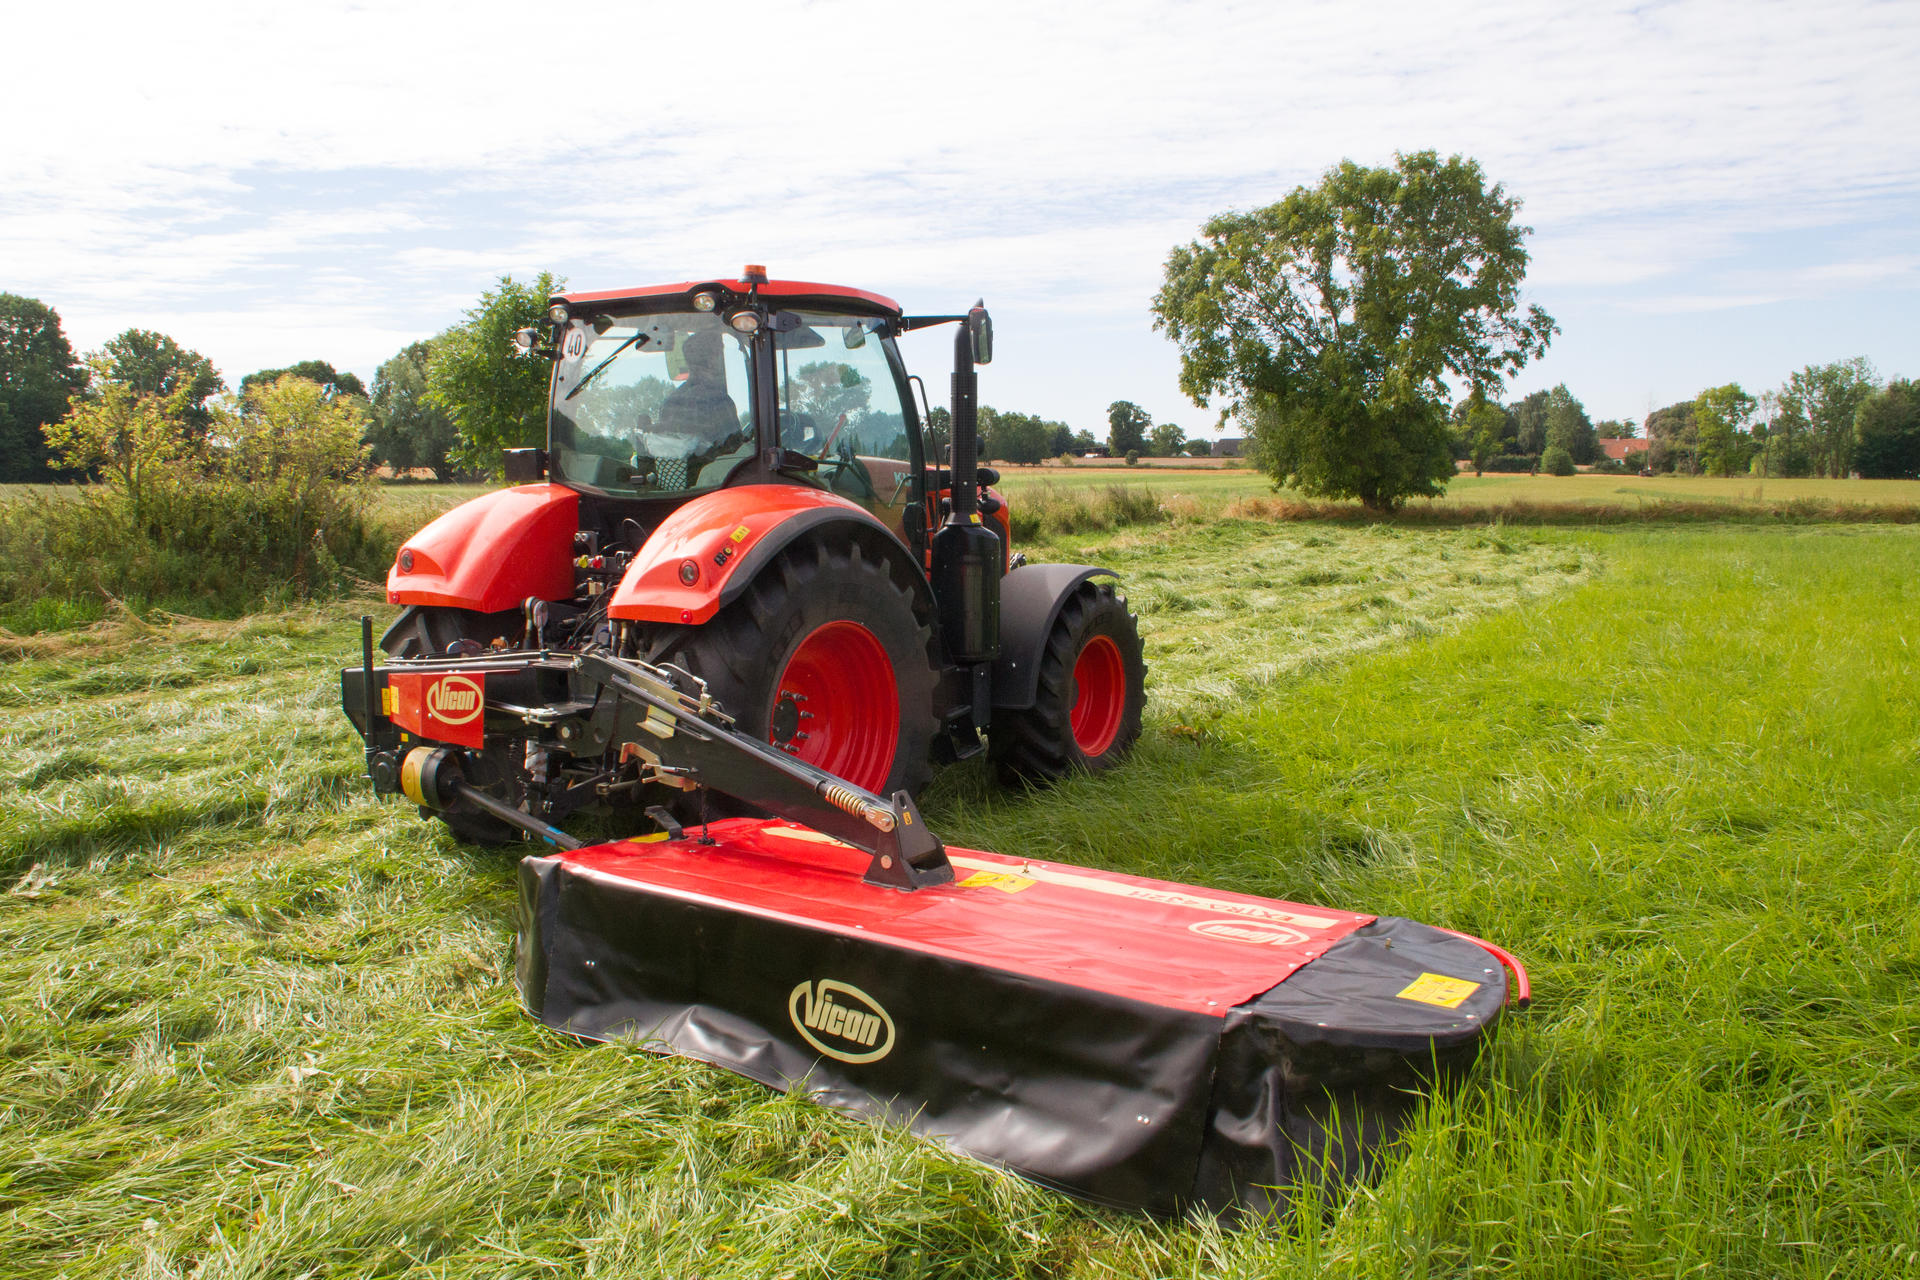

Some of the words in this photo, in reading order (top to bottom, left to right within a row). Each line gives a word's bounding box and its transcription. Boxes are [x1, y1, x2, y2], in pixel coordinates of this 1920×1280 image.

[567, 334, 582, 356] 40
[434, 678, 476, 711] Vicon
[1209, 903, 1294, 922] EXTRA
[804, 979, 882, 1047] Vicon
